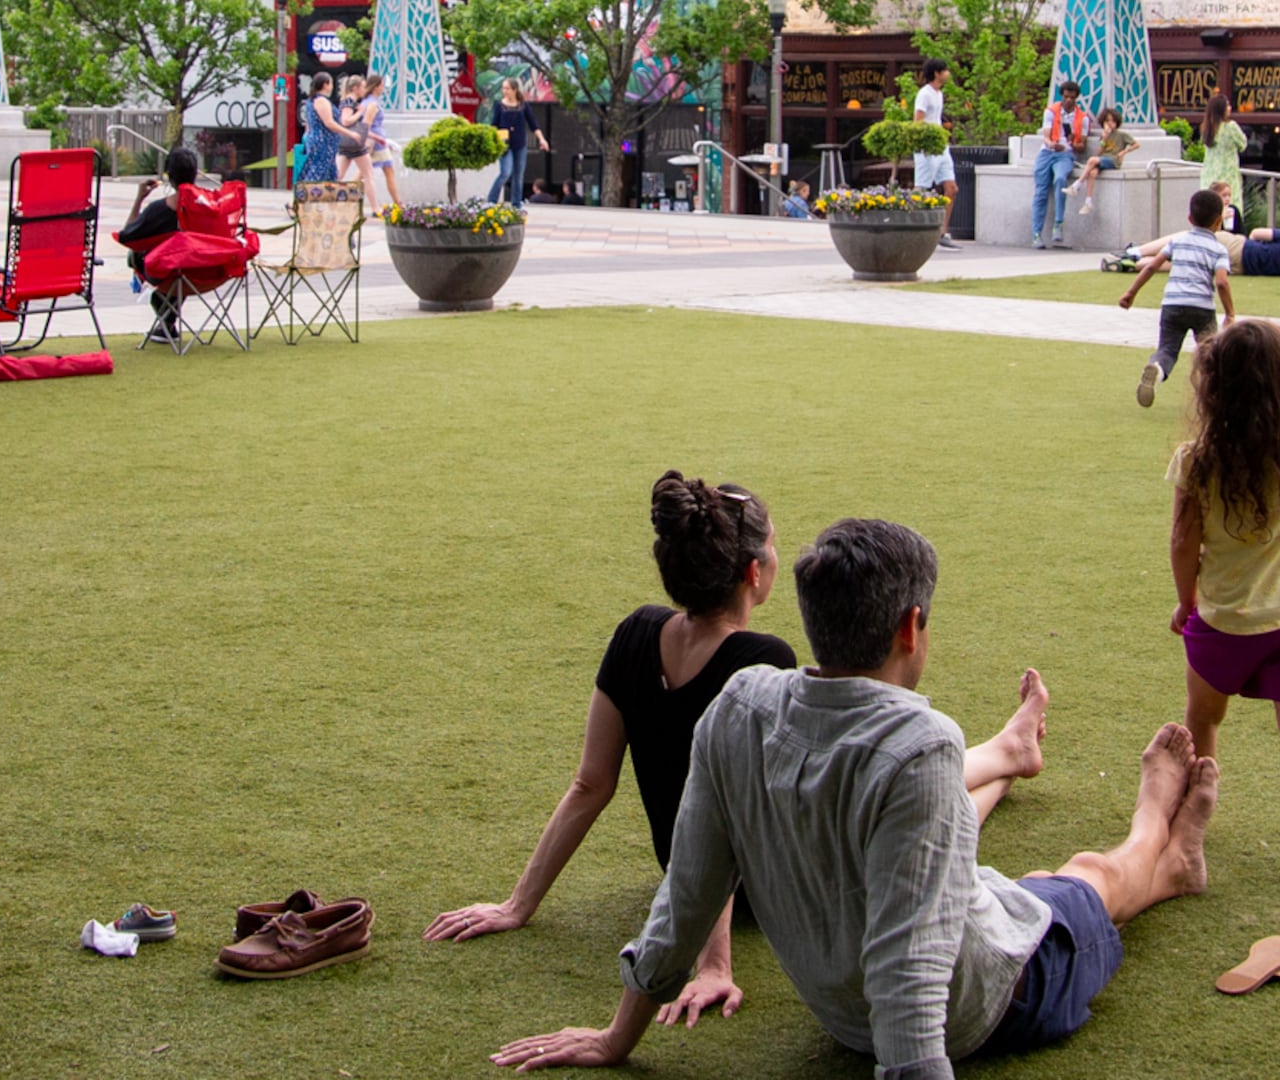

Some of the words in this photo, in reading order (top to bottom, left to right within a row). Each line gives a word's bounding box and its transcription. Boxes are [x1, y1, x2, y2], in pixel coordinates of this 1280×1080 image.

[783, 72, 826, 90] MEJOR
[840, 70, 886, 87] COSECHA
[1161, 70, 1215, 105] TAPAS
[215, 101, 271, 128] core
